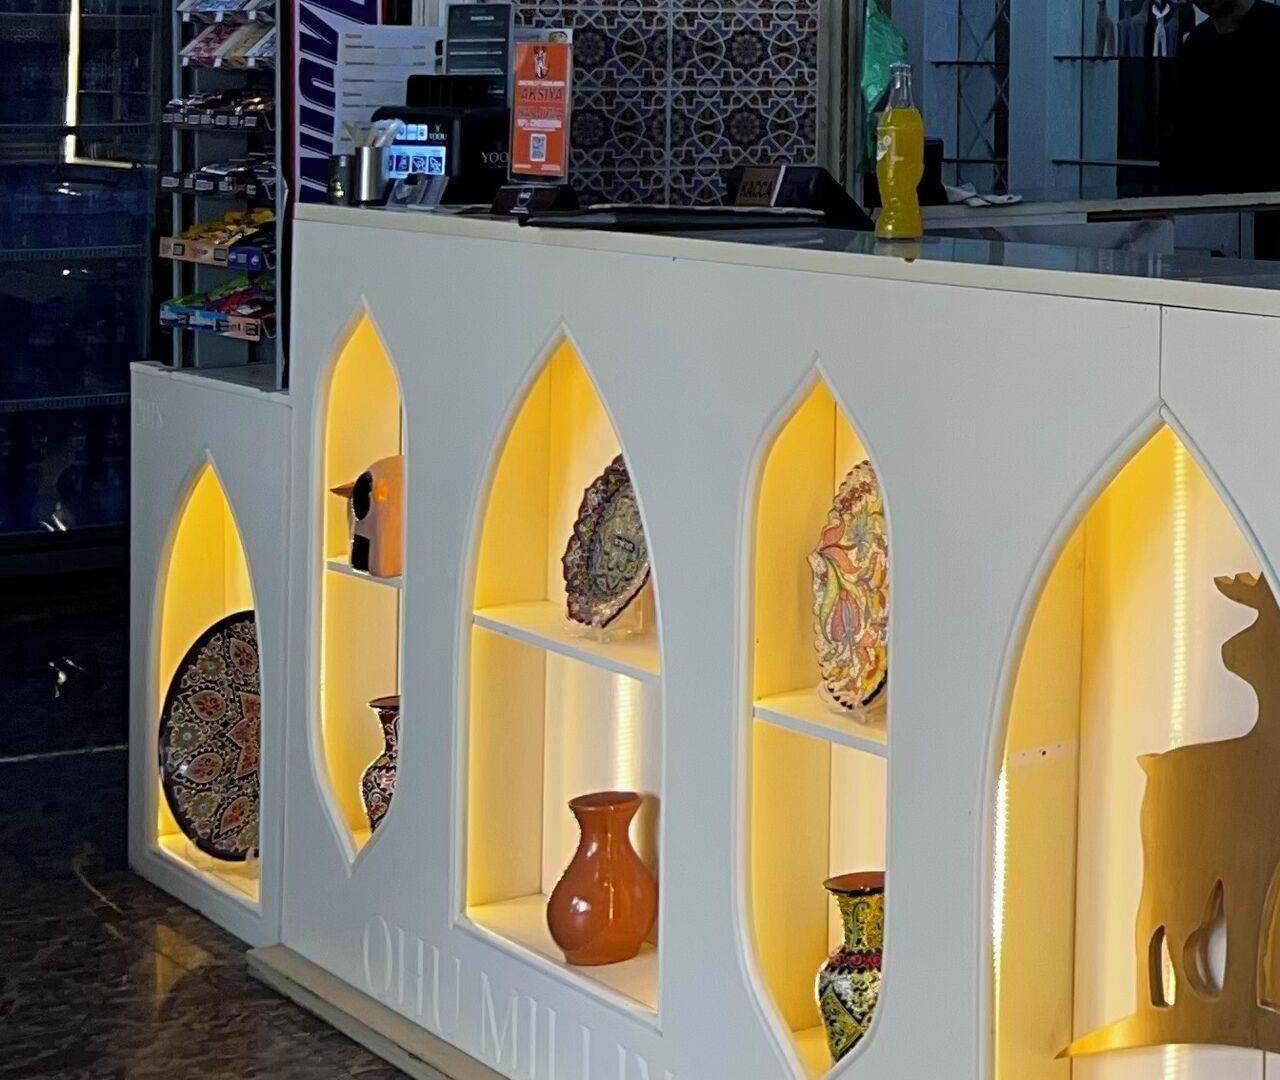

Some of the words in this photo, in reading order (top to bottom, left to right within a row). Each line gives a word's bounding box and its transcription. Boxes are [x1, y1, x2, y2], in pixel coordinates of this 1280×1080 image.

[520, 87, 563, 101] AKSIYA
[481, 151, 511, 164] YOO
[362, 915, 462, 1034] OHU
